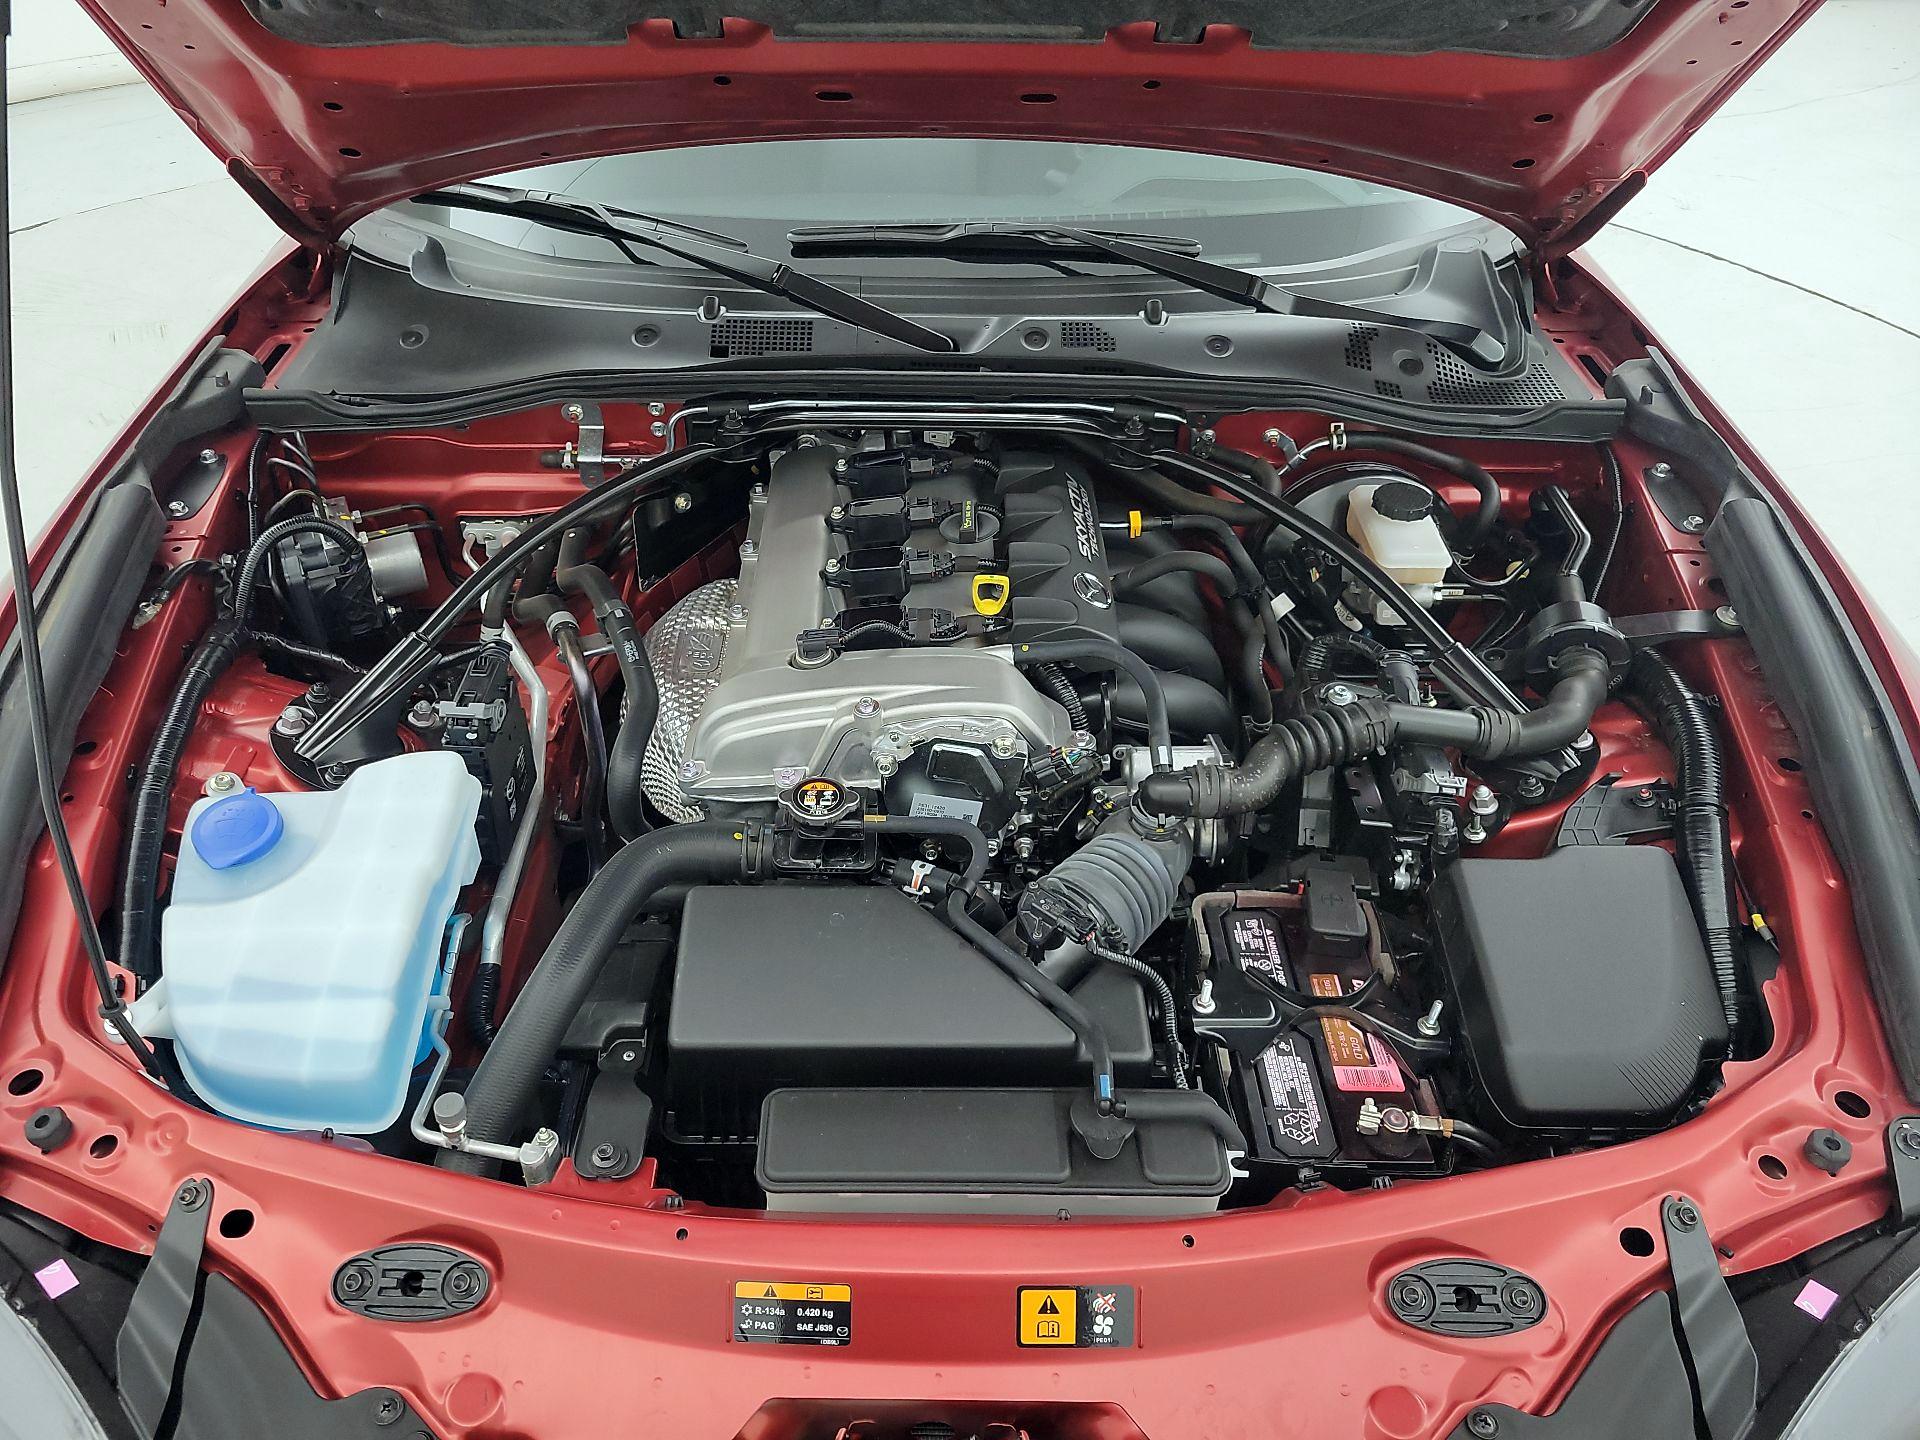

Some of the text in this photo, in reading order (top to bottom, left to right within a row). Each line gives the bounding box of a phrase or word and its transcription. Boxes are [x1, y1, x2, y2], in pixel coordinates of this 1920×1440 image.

[1065, 472, 1092, 562] SKYACTIV
[1079, 484, 1100, 558] TECHNOLOGY
[1267, 936, 1281, 964] DANGER
[1349, 1036, 1363, 1060] GOLD
[754, 1306, 834, 1319] R-134a 0.420 kg
[754, 1321, 834, 1332] PAG SAE J639
